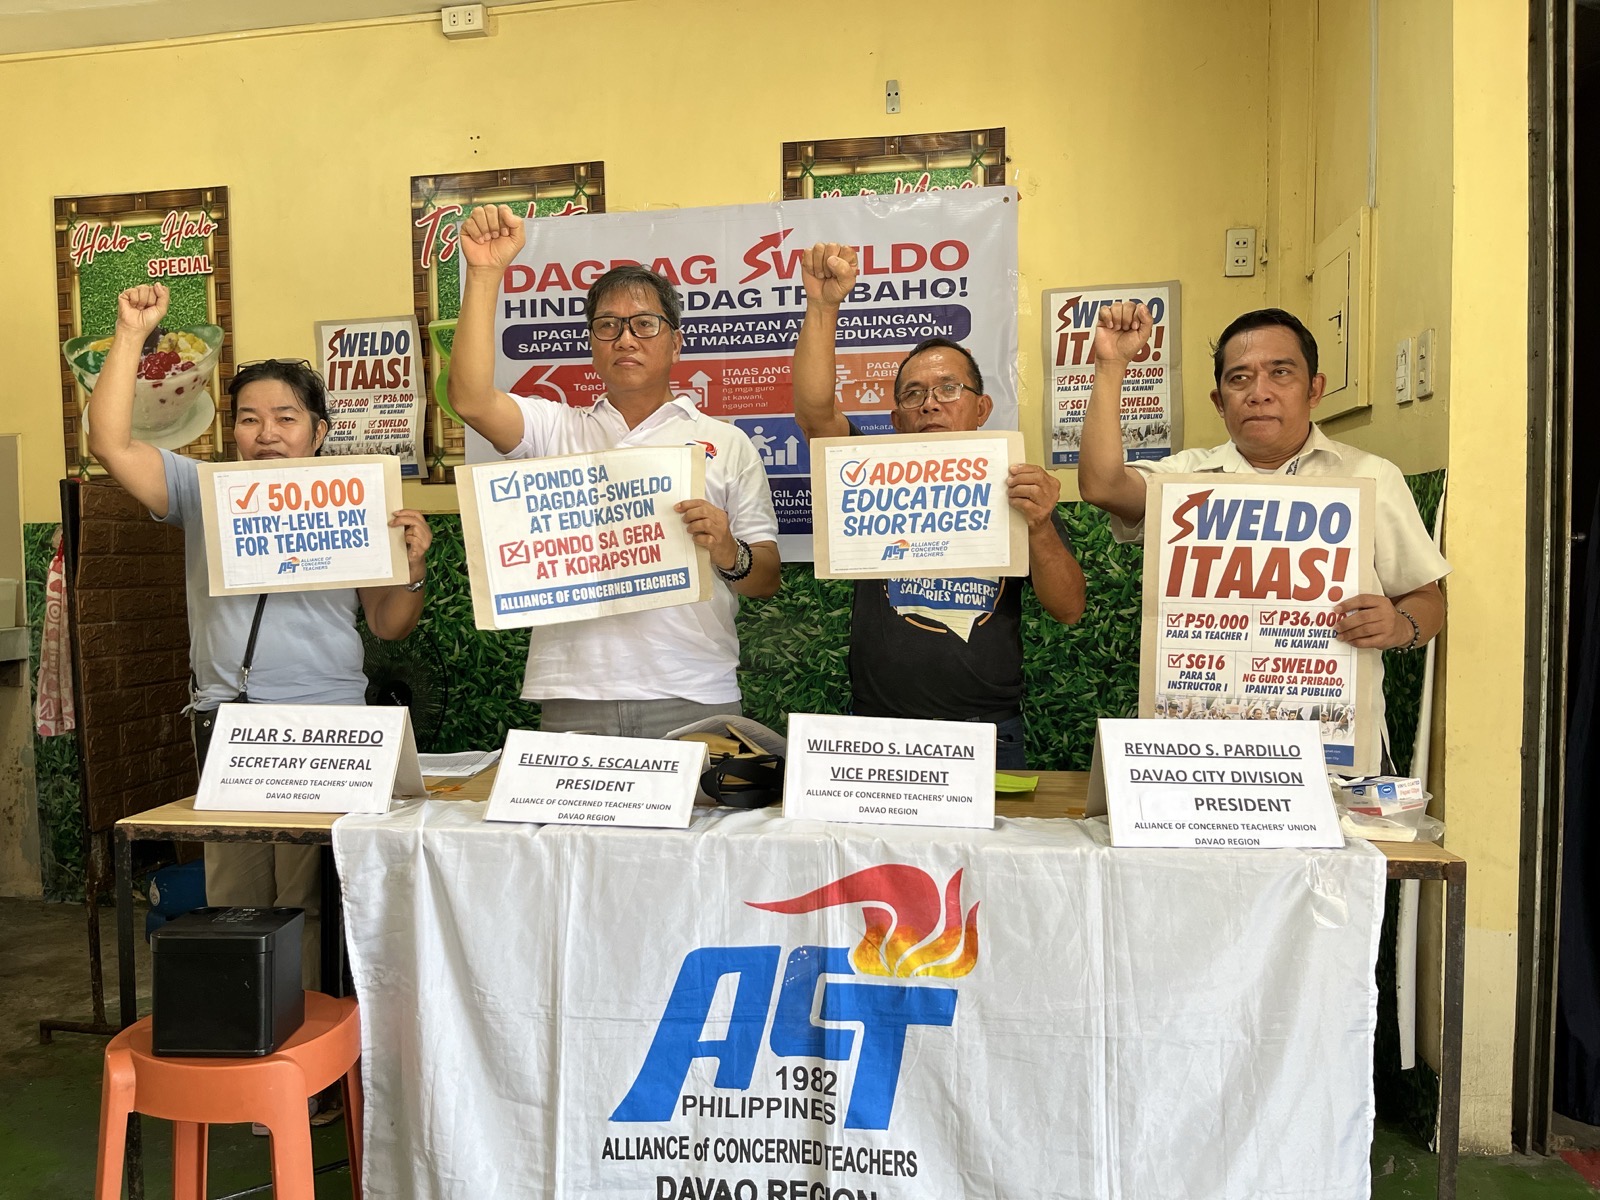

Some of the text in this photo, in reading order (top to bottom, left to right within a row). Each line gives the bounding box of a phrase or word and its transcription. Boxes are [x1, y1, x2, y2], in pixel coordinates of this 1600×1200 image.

[71, 211, 218, 266] Halo Halo
[148, 257, 213, 277] SPECIAL
[503, 254, 717, 293] DAGAG
[505, 276, 968, 318] HIND TBAHO!
[327, 328, 410, 361] SWELDO
[518, 325, 952, 353] SAPAT MAKABAYA EDUKASYON!
[328, 356, 411, 391] ITAAS!
[722, 365, 791, 377] ITAAS ANG
[722, 376, 776, 386] SWELDO
[722, 386, 733, 394] ng
[755, 385, 775, 393] guro
[731, 393, 764, 401] kawani,
[1121, 396, 1160, 407] SWELDO
[337, 420, 357, 429] SG16
[377, 419, 408, 428] SWELDO
[523, 464, 609, 492] PONDO SA
[869, 457, 989, 486] ADDRESS
[268, 478, 365, 512] 50,000
[525, 475, 672, 513] DAGDAG-SWELDO
[841, 483, 992, 514] EDUCATION
[233, 509, 367, 536] ENTRY-LEVEL PAY
[530, 498, 655, 534] AT EDUKASYON
[843, 509, 992, 537] SHORTAGES!
[1167, 488, 1352, 544] SWELDO
[235, 527, 369, 557] FOR TEACHERS!
[532, 522, 665, 558] PONDO SA GERA
[536, 543, 661, 580] AT KORAPSYON
[1165, 545, 1351, 602] ITAAS!
[500, 571, 686, 611] ALLIANCE OF CONCERNED TEACHERS
[900, 583, 986, 608] SALARIES NOW!
[1184, 610, 1347, 630] P50,000 P36,000
[1166, 629, 1242, 640] PARA SA TEACHER
[1259, 628, 1305, 638] MINIMUM
[1274, 638, 1329, 649] NG KAWANI
[1185, 653, 1226, 670] SG16
[1271, 657, 1338, 675] SWELDO
[1179, 670, 1216, 681] PARA SA
[1242, 673, 1345, 688] NG GURO SA PRIBADO,
[1167, 680, 1222, 692] INSTRUCTOR
[1245, 685, 1342, 697] IPANTAY SA PUBLIKO
[230, 727, 384, 745] PILAR S. BARREDO
[807, 738, 975, 758] WILFREDO S. LACATAN
[1124, 742, 1301, 757] REYNADO S. PARDILLO
[229, 756, 372, 771] SECRETARY GENERAL
[519, 752, 679, 772] ELENITO S. ESCALANTE
[255, 778, 264, 786] OF
[265, 778, 308, 786] CONCERNED
[348, 780, 373, 788] UNION
[830, 766, 949, 783] VICE PRESIDENT
[1130, 768, 1303, 784] DAVAO CITY DIVISION
[555, 778, 635, 792] PRESIDENT
[266, 792, 320, 800] DAVAO REGION
[510, 797, 545, 805] ALLIANCE
[557, 798, 603, 807] CONCERNED
[645, 803, 671, 811] UNION
[806, 789, 841, 797] ALLIANCE
[843, 790, 854, 798] OF
[855, 791, 902, 799] CONCERNED
[946, 795, 973, 803] UNION
[1194, 798, 1291, 812] PRESIDENT
[558, 812, 616, 822] DAVAO REGION
[858, 806, 918, 815] DAVAO REGION
[1134, 821, 1173, 830] ALLIANCE
[1175, 822, 1186, 830] OF
[1188, 822, 1239, 831] CONCERNED
[1287, 823, 1317, 831] UNION
[1195, 837, 1260, 846] DAVAO REGION
[608, 944, 959, 1130] ACT
[775, 1065, 837, 1096] 1982
[682, 1094, 836, 1125] PHILIPPINES
[602, 1135, 918, 1178] ALLIANCE of CONCERNED TEACHERS
[656, 1176, 758, 1200] DAVAO
